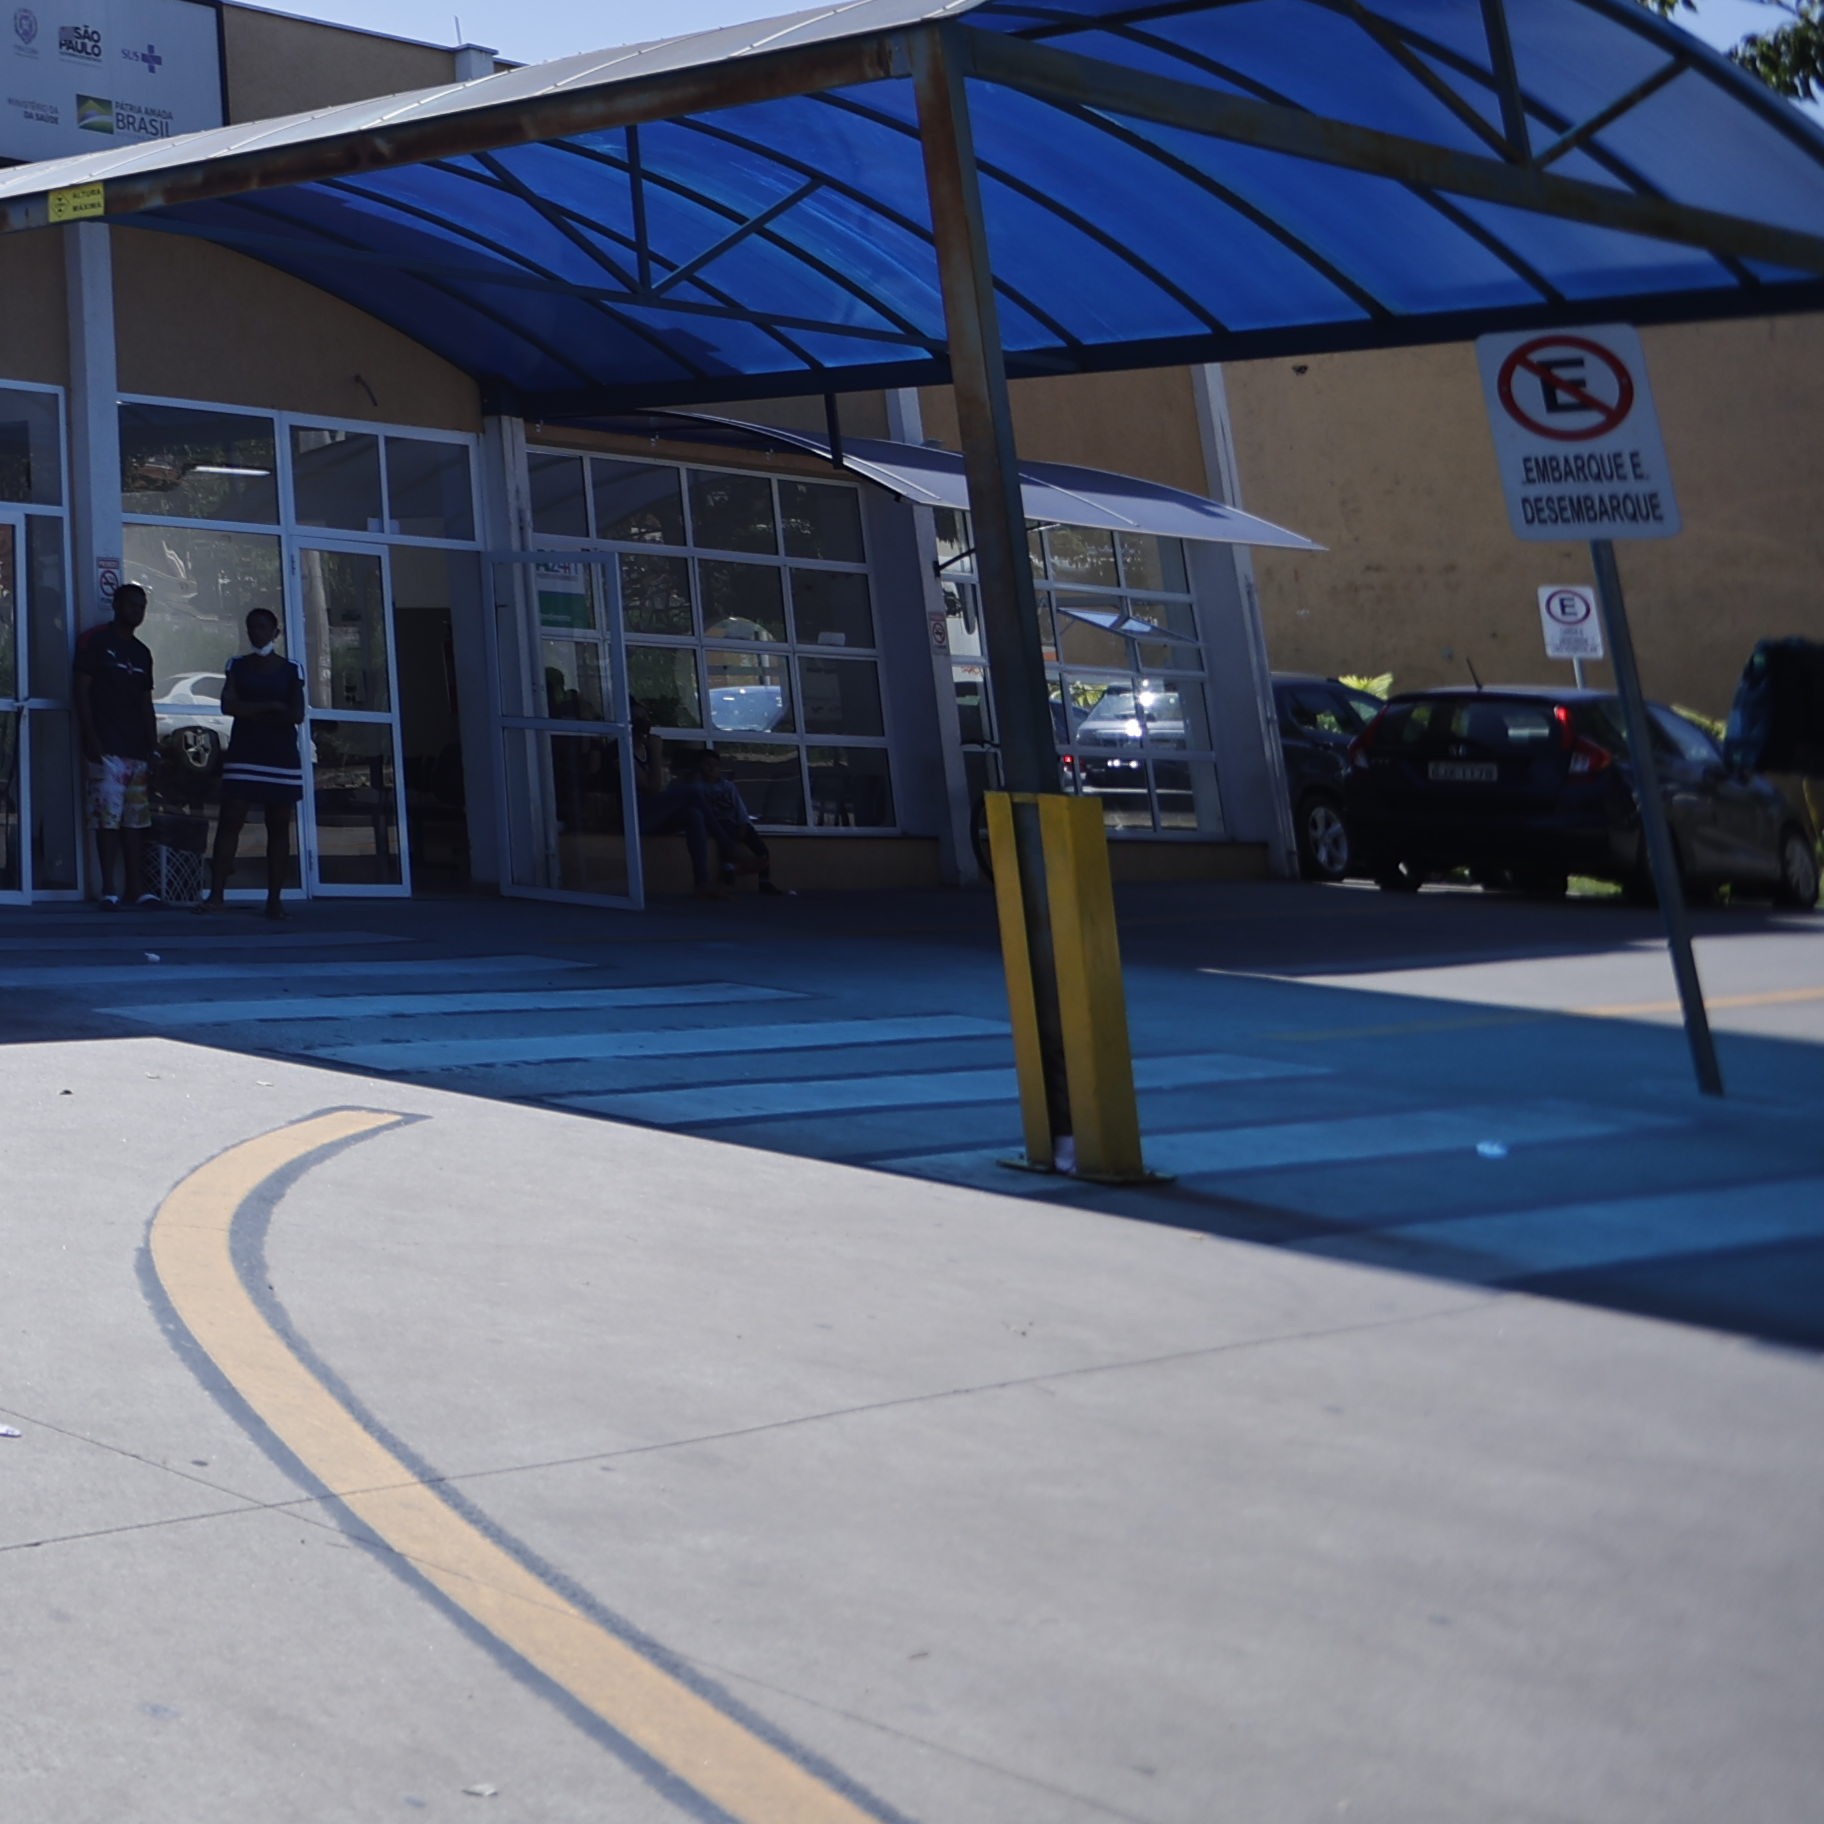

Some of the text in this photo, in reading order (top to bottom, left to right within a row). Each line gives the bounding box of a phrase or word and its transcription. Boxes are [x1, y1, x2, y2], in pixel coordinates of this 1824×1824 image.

[74, 25, 101, 43] SÃO
[59, 40, 102, 57] PAULO
[121, 48, 140, 62] SUS
[115, 112, 170, 137] BRASIL
[1523, 451, 1646, 484] EMBARQUE E
[1521, 493, 1664, 525] DESEMBARQUE
[1559, 597, 1578, 616] E
